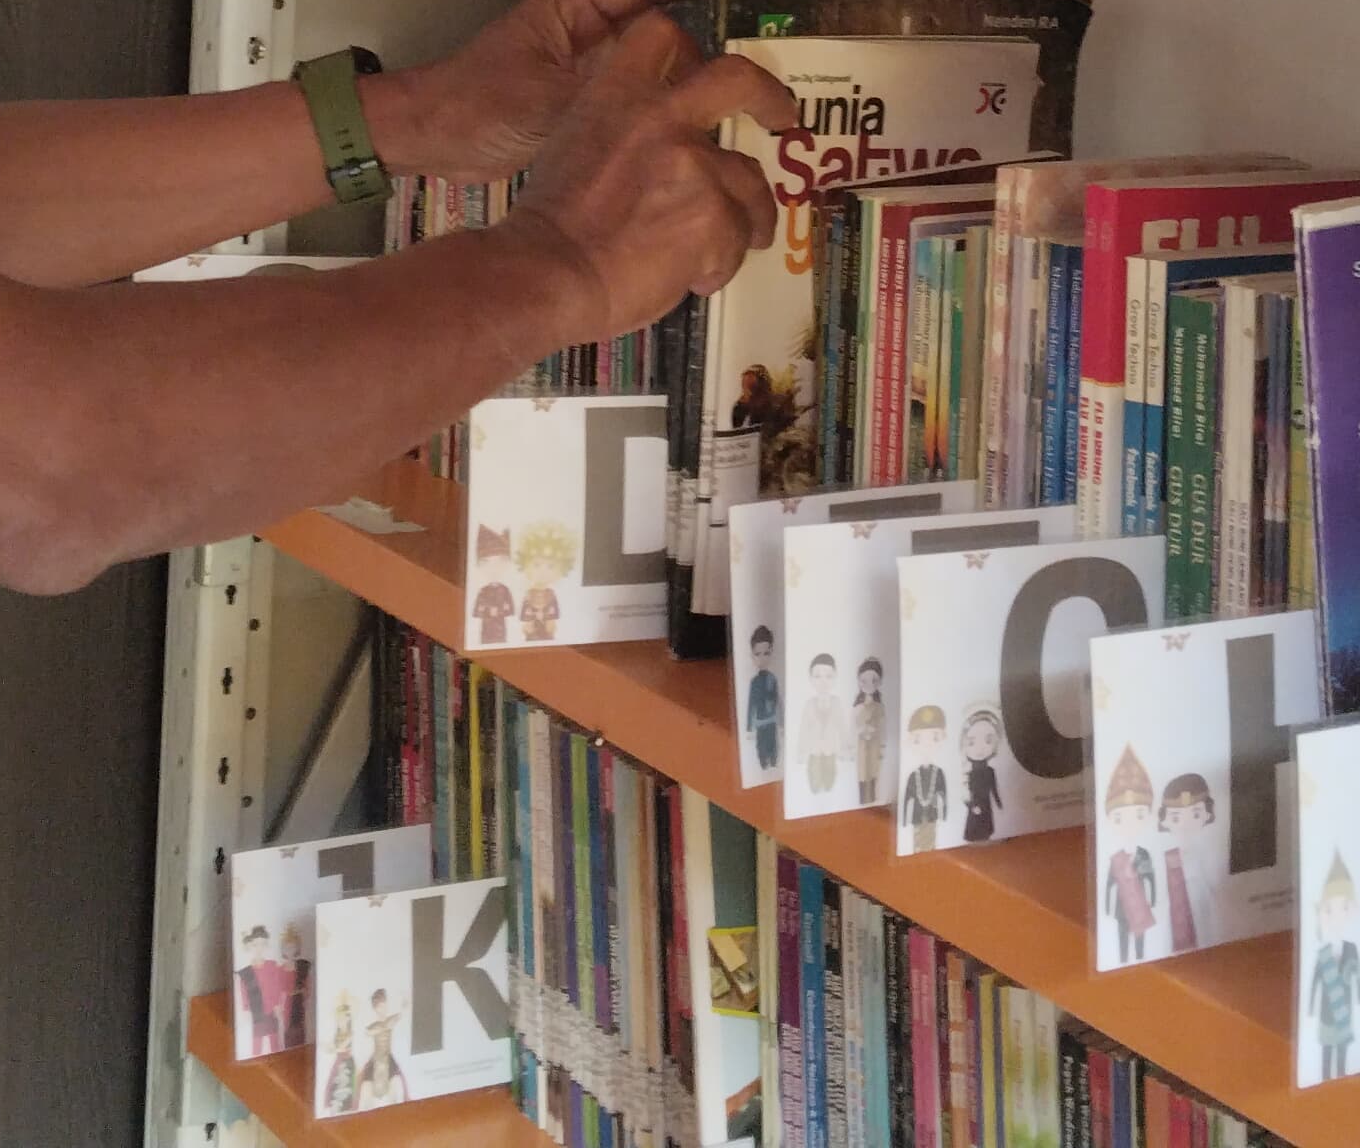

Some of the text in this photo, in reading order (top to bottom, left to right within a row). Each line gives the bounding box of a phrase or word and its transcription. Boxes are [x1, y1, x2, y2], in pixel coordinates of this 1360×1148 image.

[778, 85, 886, 137] unia
[1125, 448, 1139, 506] facebook
[1169, 466, 1184, 505] GUS
[1190, 474, 1207, 513] GUS
[1168, 512, 1183, 557] DUR
[1189, 519, 1206, 565] DUR
[410, 885, 512, 1056] K
